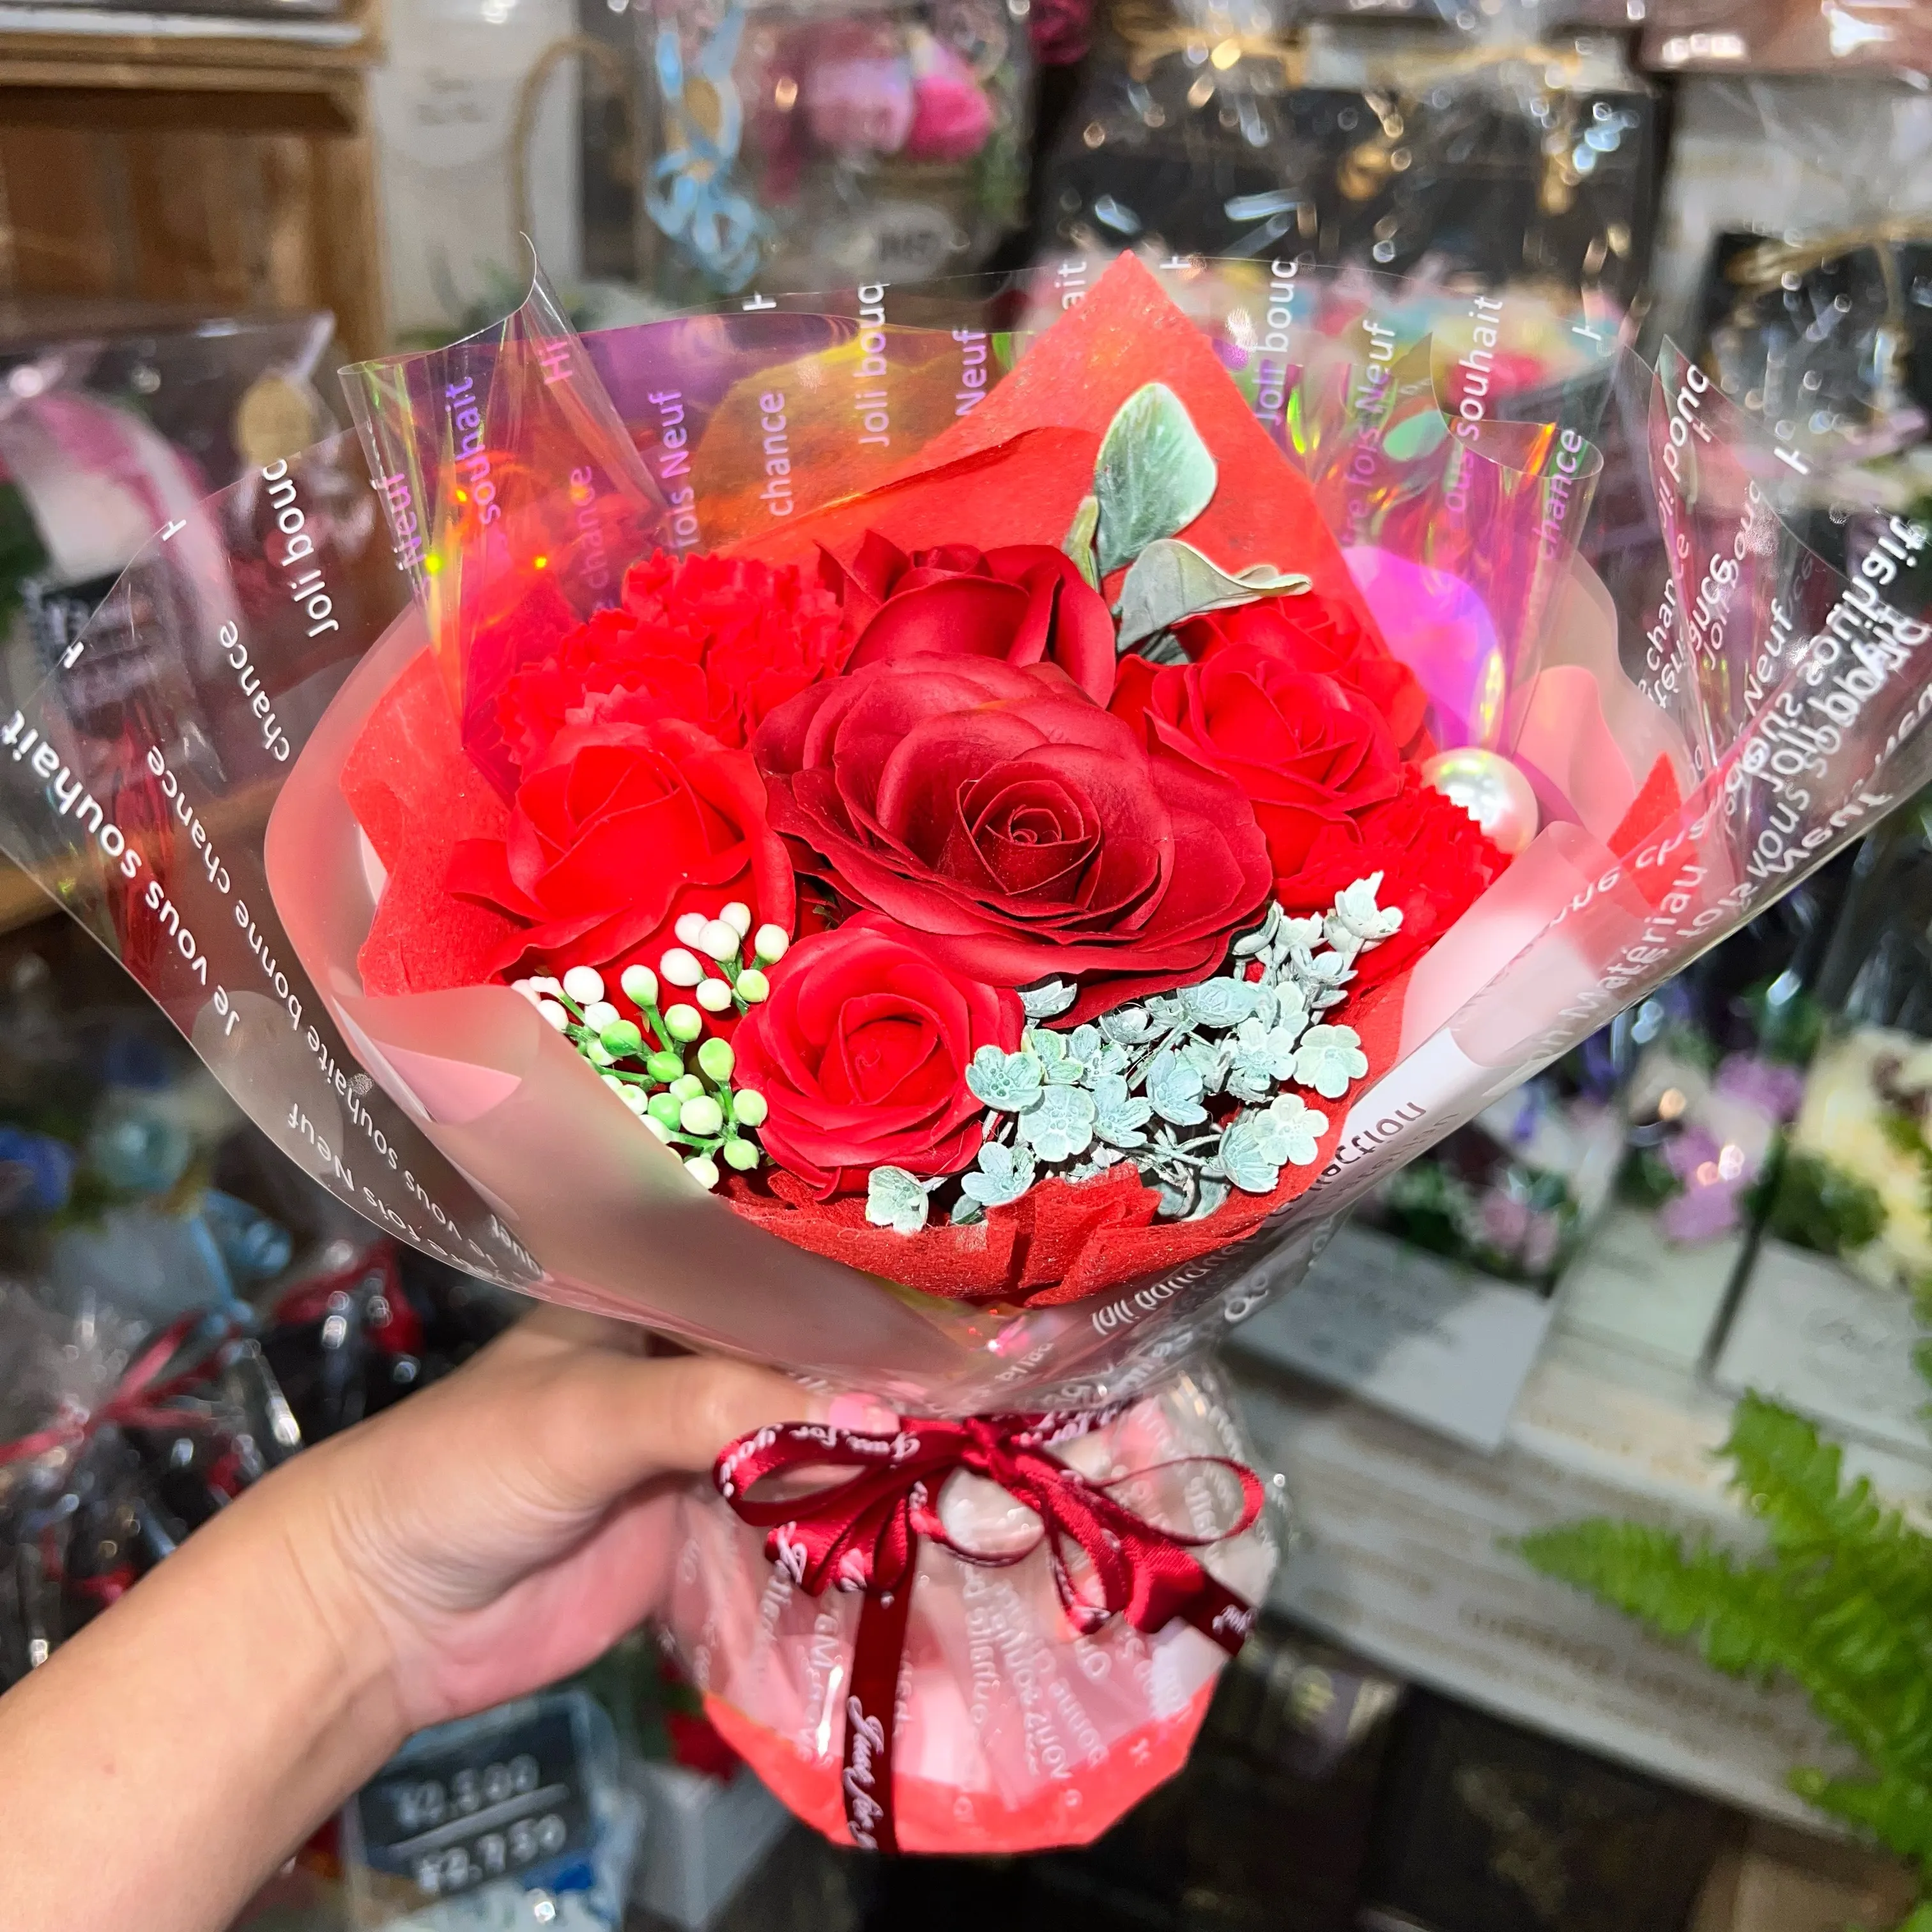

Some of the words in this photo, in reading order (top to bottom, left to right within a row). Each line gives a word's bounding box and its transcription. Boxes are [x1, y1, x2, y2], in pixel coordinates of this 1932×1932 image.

[537, 341, 573, 386] Hi
[952, 328, 986, 417] Neuf
[1354, 319, 1397, 414] Neuf
[1456, 296, 1503, 442] souhait
[445, 375, 502, 525] souhait
[647, 388, 691, 479] Neuf
[759, 389, 794, 517] chance
[855, 388, 890, 447] Joli
[291, 568, 339, 638] Joli
[220, 620, 290, 762] chance
[1742, 597, 1793, 716] Neuf
[0, 709, 142, 879] souhait
[147, 744, 232, 895] chance
[144, 880, 209, 986] vous
[234, 899, 303, 1032] bonne
[213, 985, 240, 1036] Je
[288, 1103, 355, 1192] Neuf
[307, 1025, 398, 1170] souhaite
[404, 1169, 463, 1241] vous
